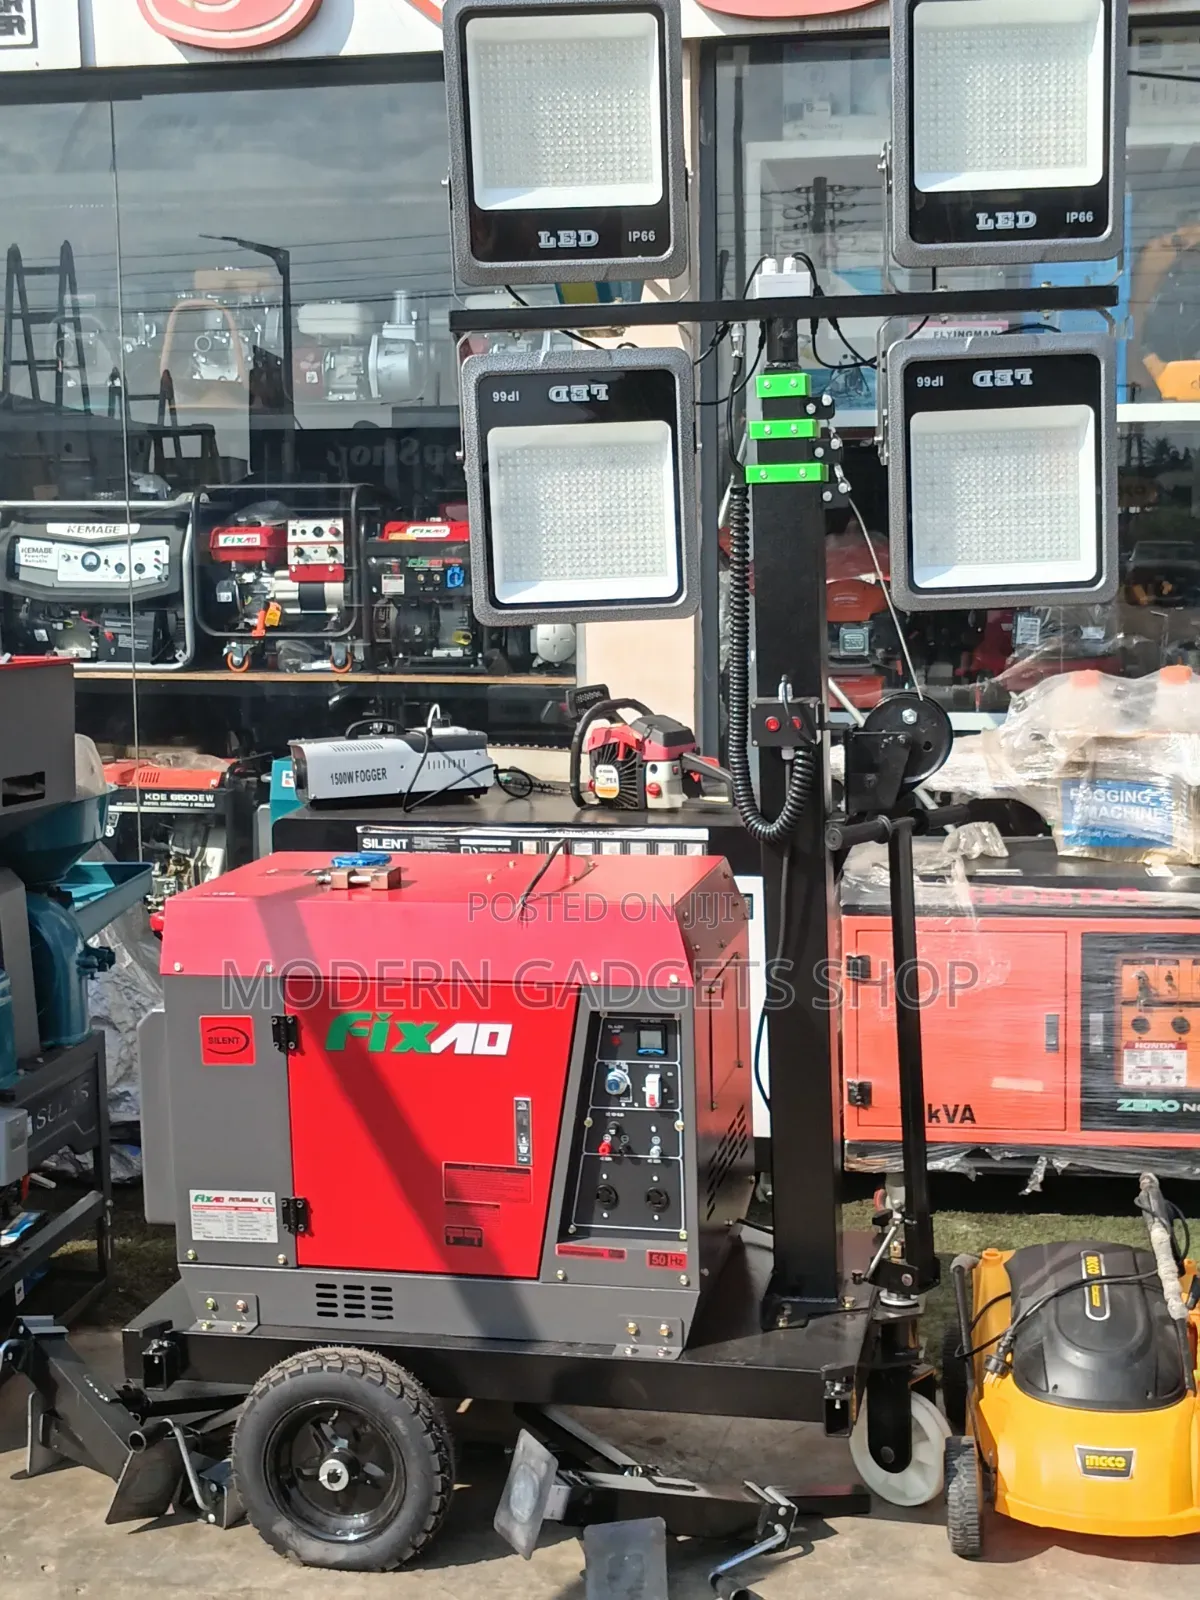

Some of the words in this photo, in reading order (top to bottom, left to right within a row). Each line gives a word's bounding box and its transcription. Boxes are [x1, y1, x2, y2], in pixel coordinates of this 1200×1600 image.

[976, 211, 1037, 230] LED
[1066, 211, 1094, 223] IP66
[538, 229, 599, 248] LED
[628, 230, 656, 242] IP66
[933, 330, 998, 338] FLYINGMAN
[916, 376, 944, 387] IP66
[972, 368, 1033, 387] LED
[492, 391, 520, 402] IP66
[548, 384, 609, 402] LED
[67, 525, 120, 534] KEMAGE
[330, 771, 354, 785] 1500W
[355, 768, 387, 783] FOGGER
[362, 838, 408, 849] SILENT
[208, 1036, 240, 1045] SILENT
[1116, 1098, 1180, 1113] ZERO
[927, 1103, 976, 1124] kVA
[651, 1254, 666, 1265] 50
